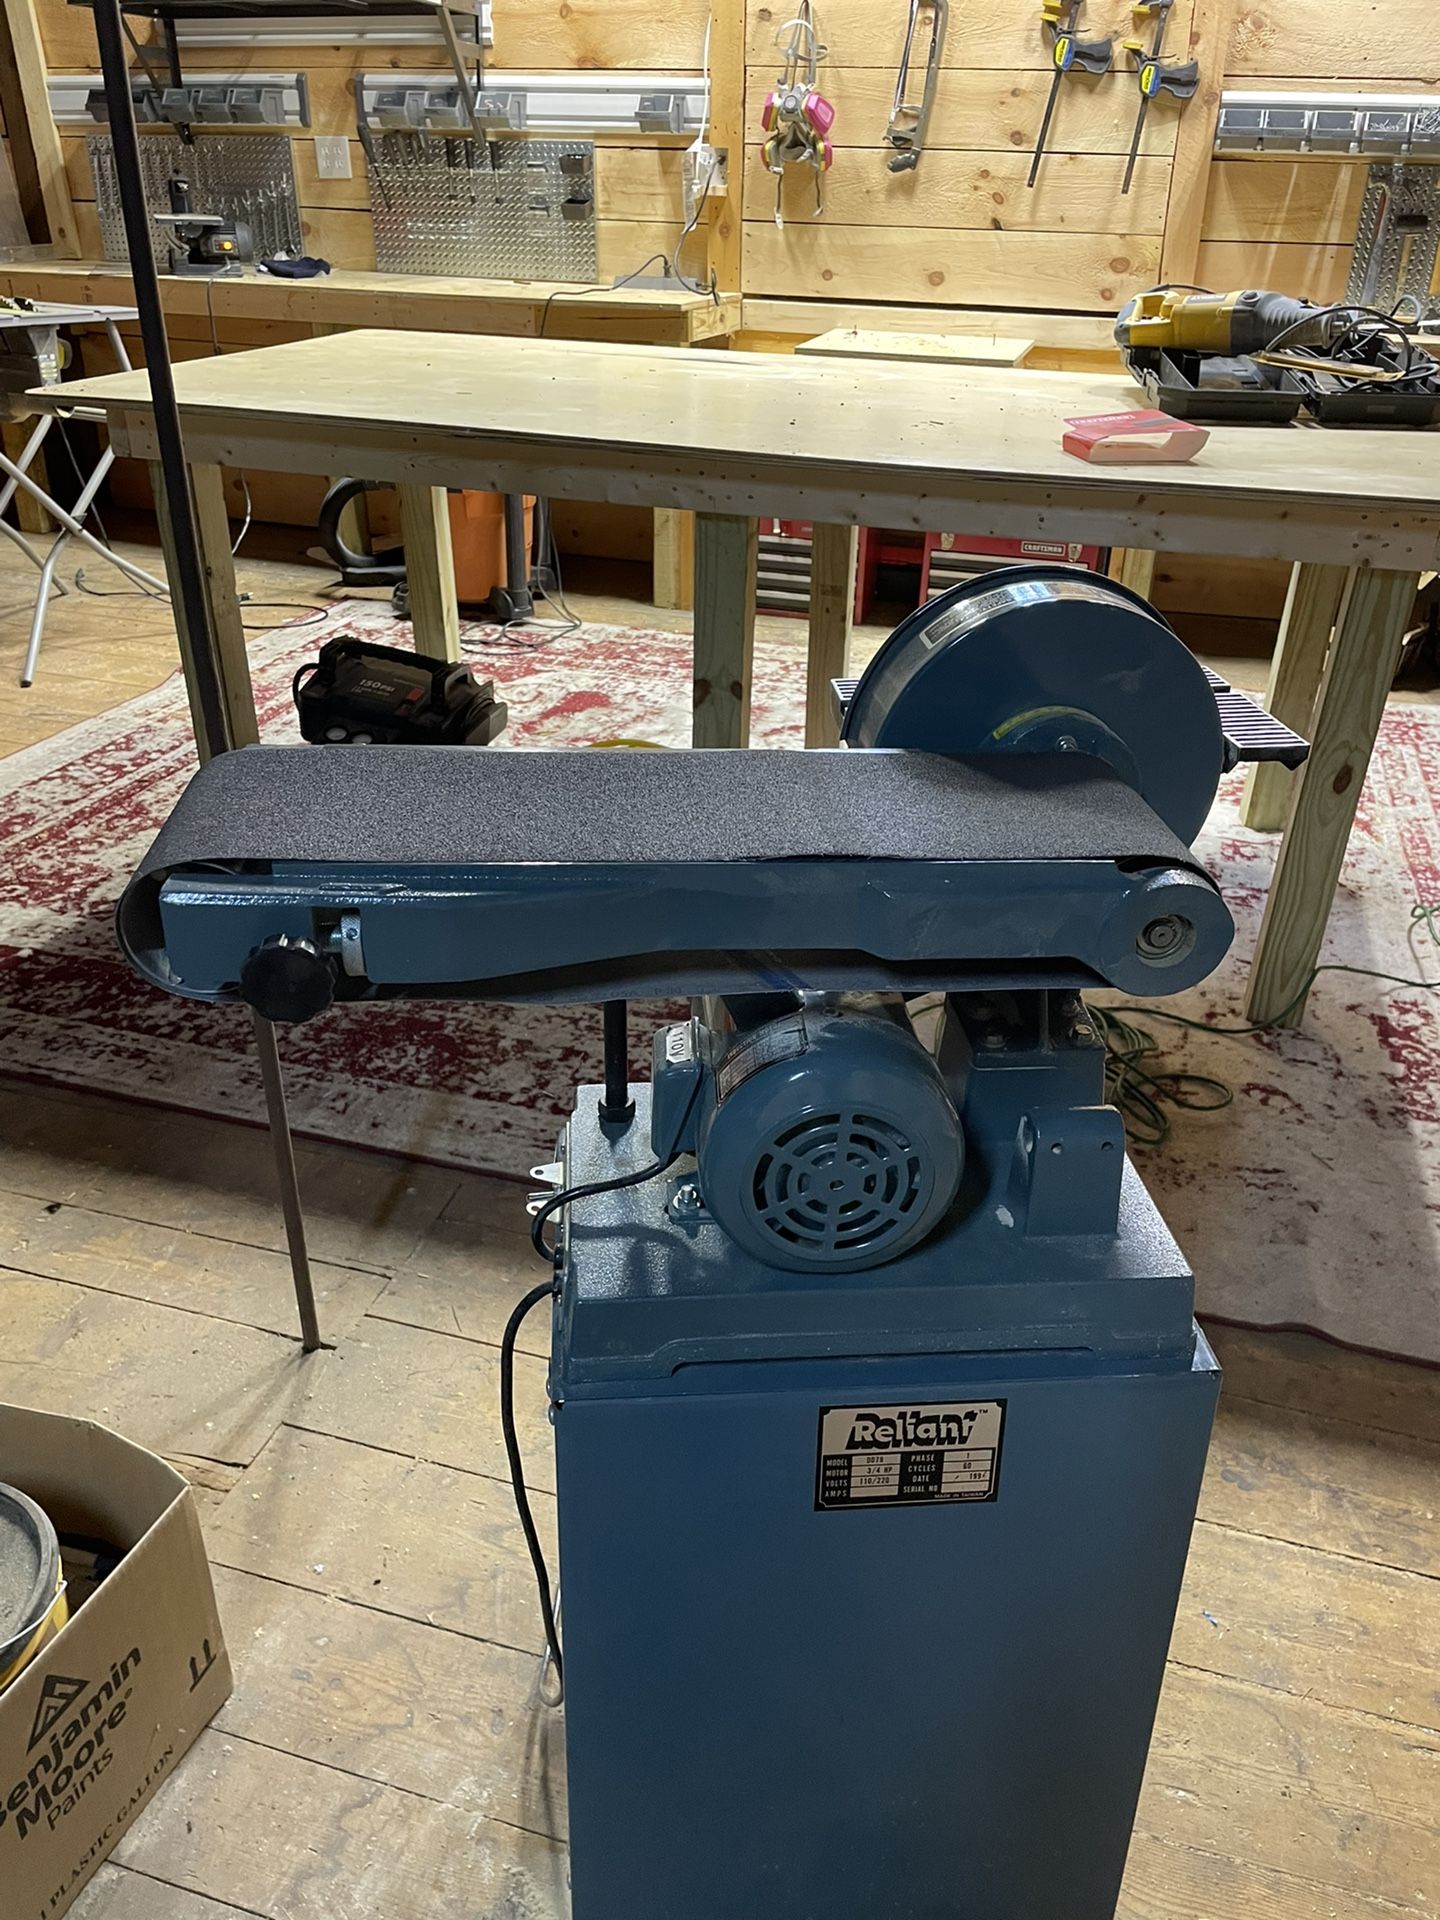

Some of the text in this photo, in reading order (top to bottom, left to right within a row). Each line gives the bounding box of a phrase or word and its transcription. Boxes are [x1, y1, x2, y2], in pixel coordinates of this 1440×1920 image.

[1024, 544, 1063, 553] CRAFTSMAN
[359, 679, 381, 688] 150
[668, 1031, 685, 1057] 110V
[845, 1410, 978, 1450] Reliant
[826, 1458, 848, 1466] MODEL
[911, 1454, 935, 1462] PHASE
[826, 1469, 849, 1477] MOTOR
[866, 1467, 881, 1475] 3/4
[908, 1464, 936, 1473] CYCLES
[825, 1477, 890, 1487] VOLTS 110/220
[16, 1701, 127, 1840] Moore
[47, 1748, 114, 1832] Paints
[49, 1823, 114, 1909] PLASTIC
[117, 1744, 174, 1824] GALLON
